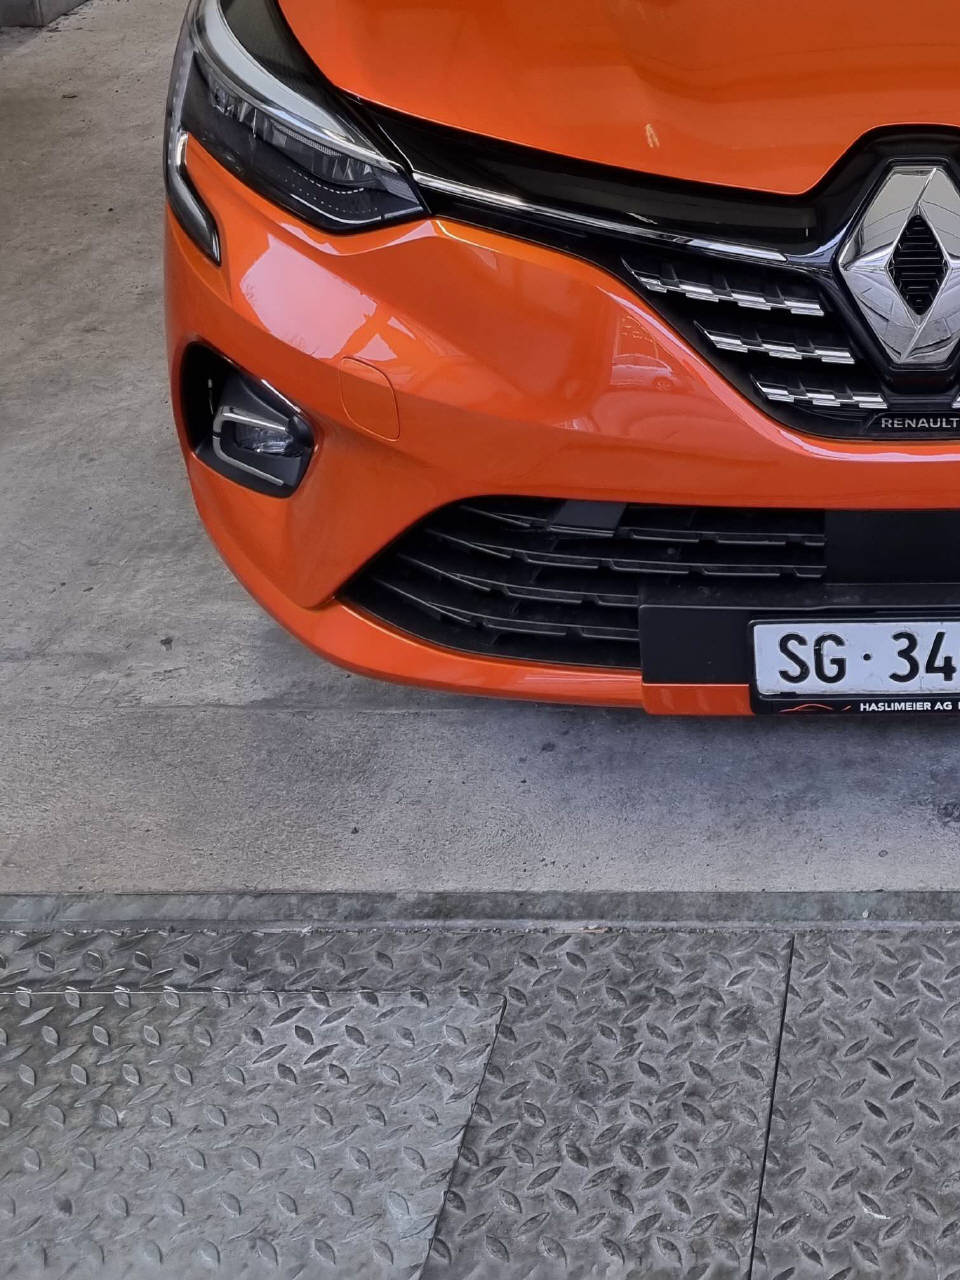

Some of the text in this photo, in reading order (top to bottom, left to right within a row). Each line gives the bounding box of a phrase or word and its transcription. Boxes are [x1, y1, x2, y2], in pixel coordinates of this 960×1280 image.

[880, 417, 960, 428] RENAULT
[778, 632, 848, 684] SG
[859, 701, 932, 712] HASLIMEIER
[933, 701, 953, 711] AG
